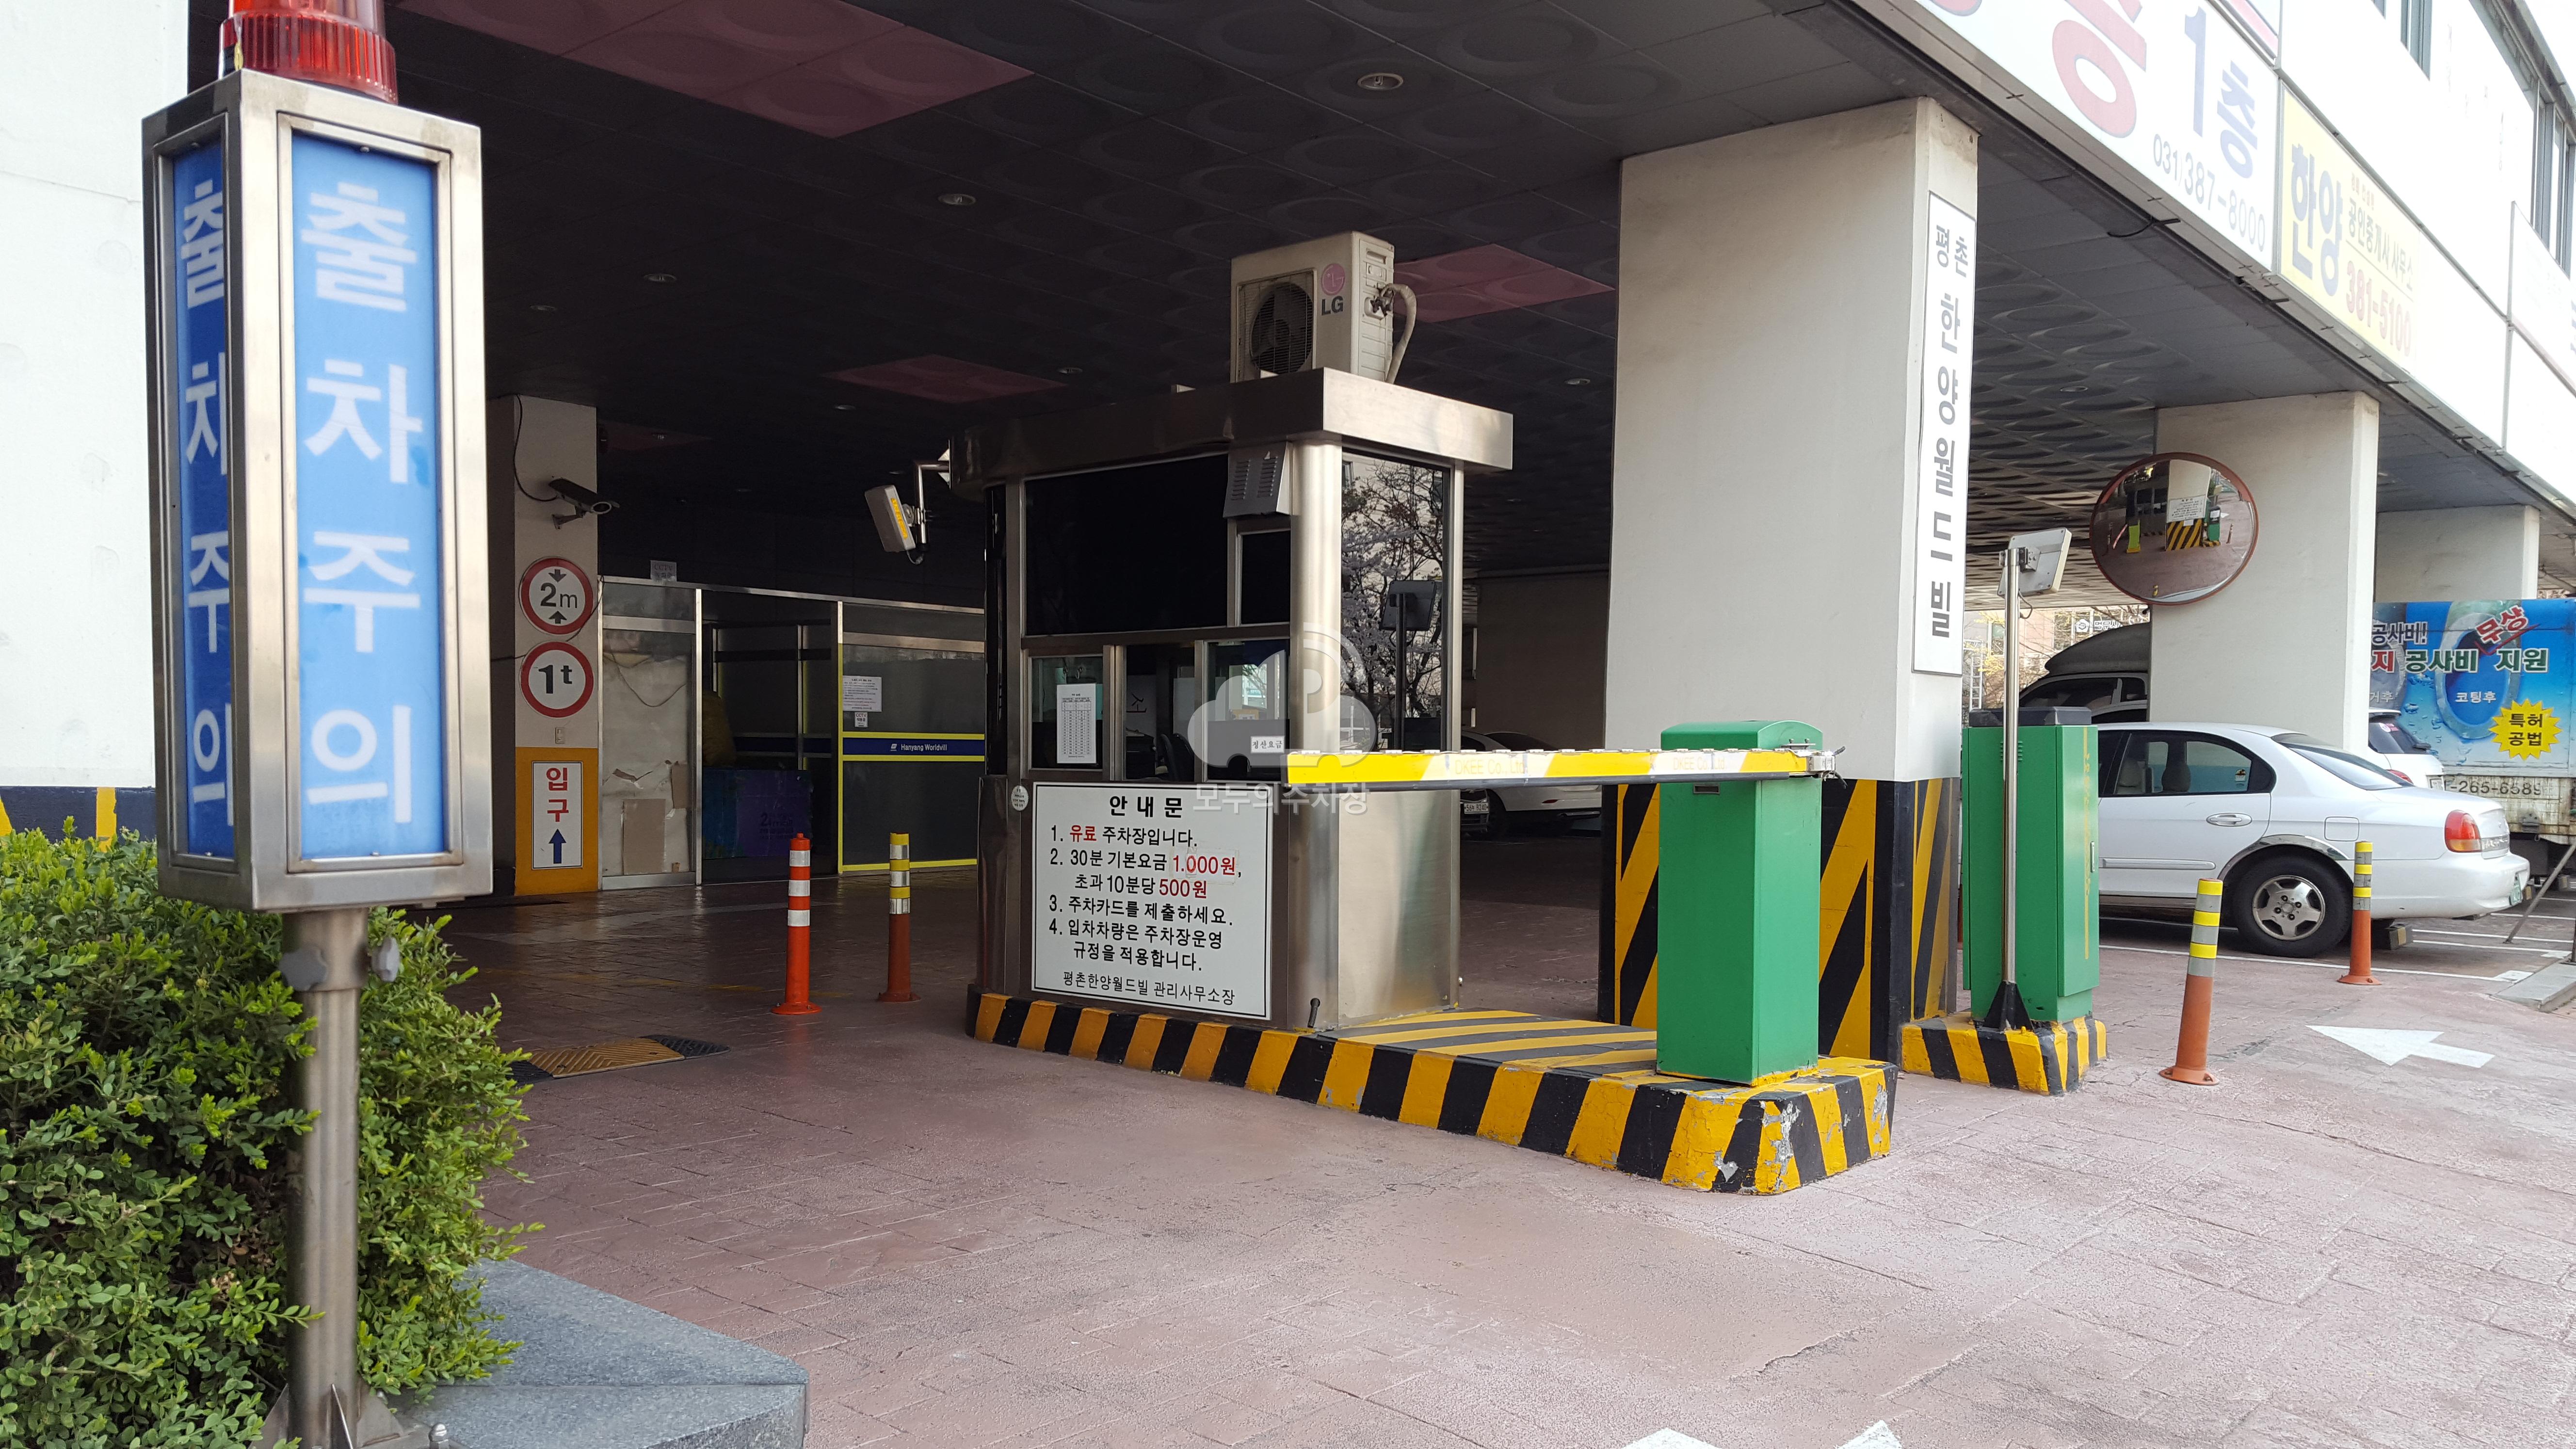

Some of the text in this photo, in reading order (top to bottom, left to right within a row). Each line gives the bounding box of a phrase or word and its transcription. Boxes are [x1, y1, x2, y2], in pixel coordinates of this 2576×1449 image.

[2185, 6, 2257, 178] 1층
[2153, 134, 2266, 252] 031)387-8000
[2292, 143, 2343, 296] 한양
[1936, 224, 1968, 278] 평촌
[1321, 295, 1343, 316] LG
[2346, 260, 2412, 357] 381-5100
[301, 181, 423, 824] 출차주의
[540, 582, 578, 609] 2m
[2372, 622, 2428, 645] 공사비!
[2476, 605, 2528, 645] 무상
[2405, 649, 2479, 674] 공사비
[2496, 648, 2549, 673] 지원
[538, 664, 573, 694] 1t
[2455, 691, 2497, 703] 코팅후
[2509, 713, 2543, 728] 특허
[901, 743, 924, 752] Hanyang
[1252, 740, 1283, 749] 정산요금
[2508, 732, 2543, 747] 공법
[546, 767, 569, 823] 입구
[1051, 825, 1197, 847] 1. 유료 주차장입니다.
[1050, 848, 1241, 878] 2. 30분 기본요금 1.000원,
[1075, 874, 1207, 899] 초과 10분당 500원
[1049, 894, 1233, 926] 3. 주차카드를 제출하세요.
[1049, 918, 1222, 950] 4. 입차차량은 주차장운영
[1074, 941, 1202, 971] 규정을 적용합니다.
[1063, 971, 1235, 1006] 평촌한양월드빌 관리사무소장
